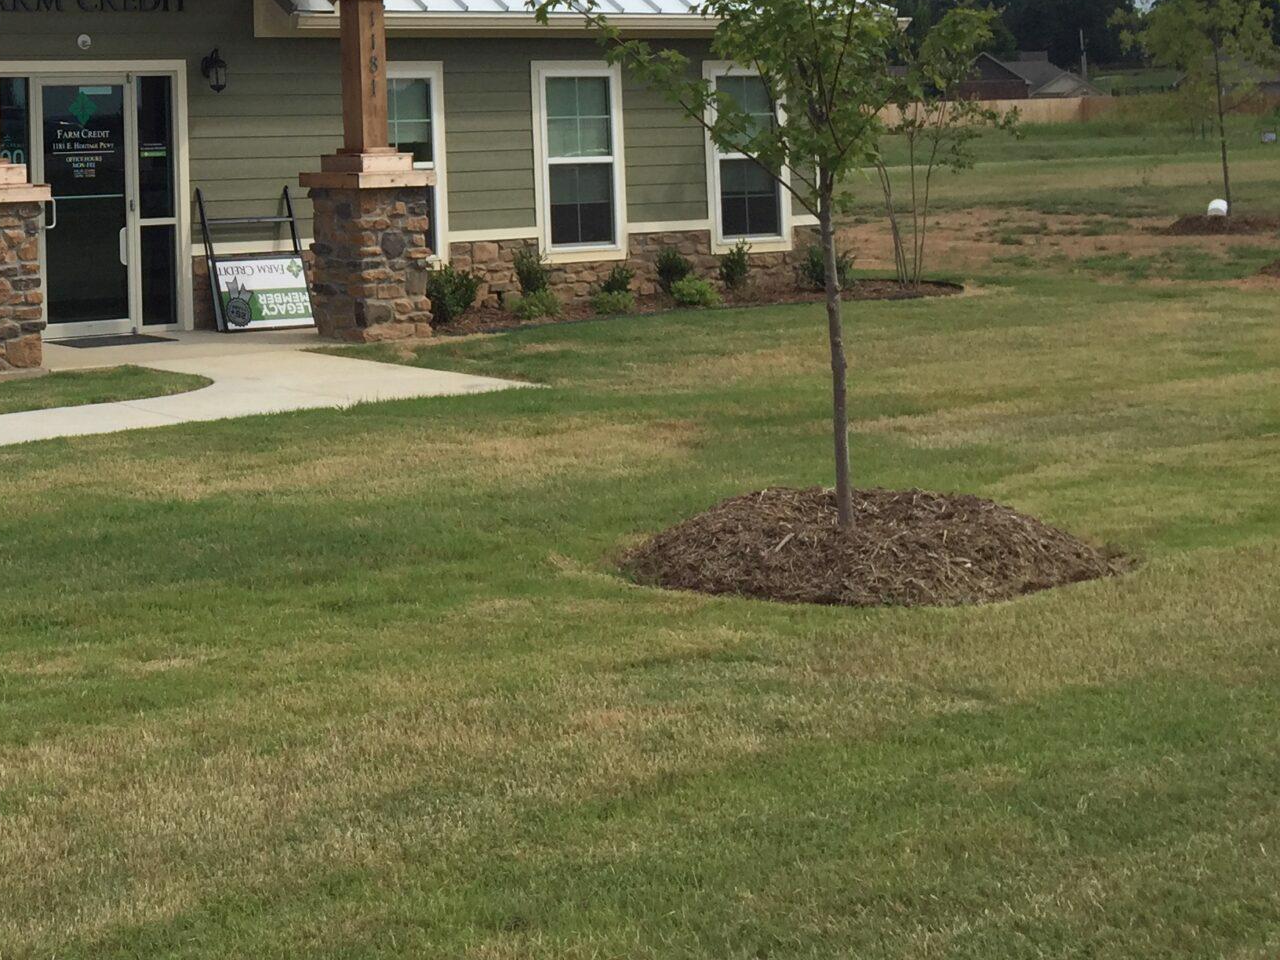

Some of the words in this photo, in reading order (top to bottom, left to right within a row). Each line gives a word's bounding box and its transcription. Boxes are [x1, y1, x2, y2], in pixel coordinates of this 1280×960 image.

[56, 129, 80, 139] FARM
[81, 129, 110, 138] CREDIT
[218, 263, 255, 276] CREDIT
[257, 263, 285, 275] FARM
[259, 291, 311, 305] MEMBER
[261, 302, 312, 316] LEGACY
